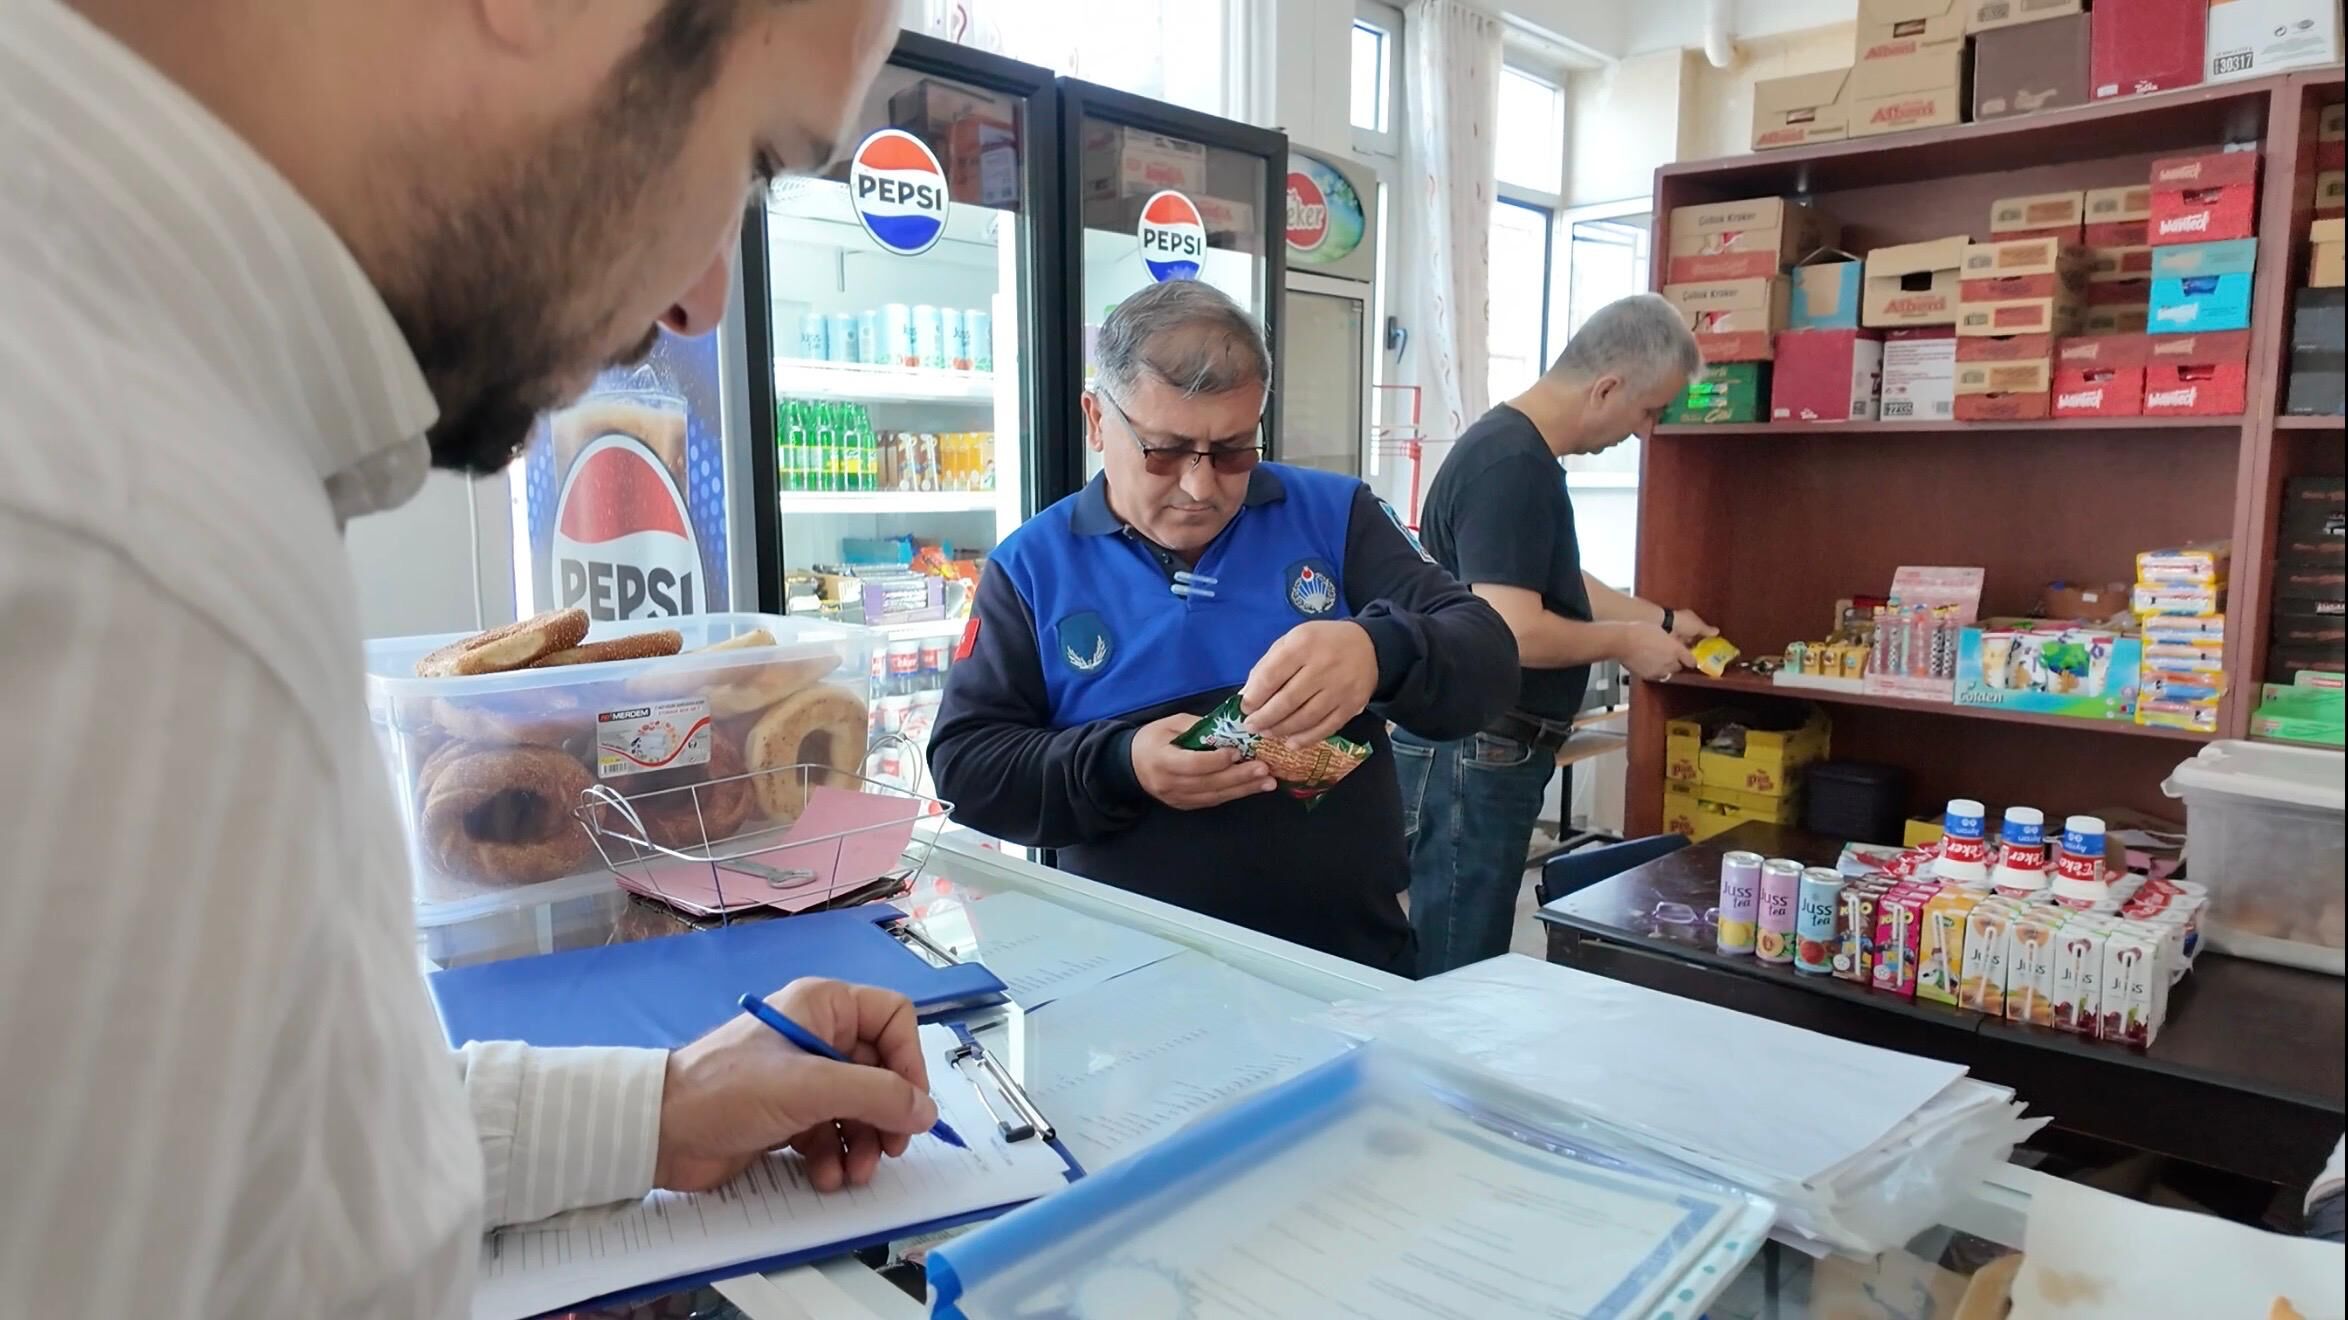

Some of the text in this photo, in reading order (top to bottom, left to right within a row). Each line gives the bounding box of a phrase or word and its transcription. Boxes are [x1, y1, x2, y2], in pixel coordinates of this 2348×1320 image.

[858, 173, 942, 211] PEPSI
[1144, 228, 1202, 256] PEPSI
[560, 558, 694, 622] PEPSI
[612, 708, 650, 720] MERDEM
[1722, 881, 1752, 899] Juss
[1733, 897, 1751, 909] tea
[1768, 904, 1786, 917] tea
[1801, 897, 1833, 915] Juss
[1812, 913, 1831, 926] tea
